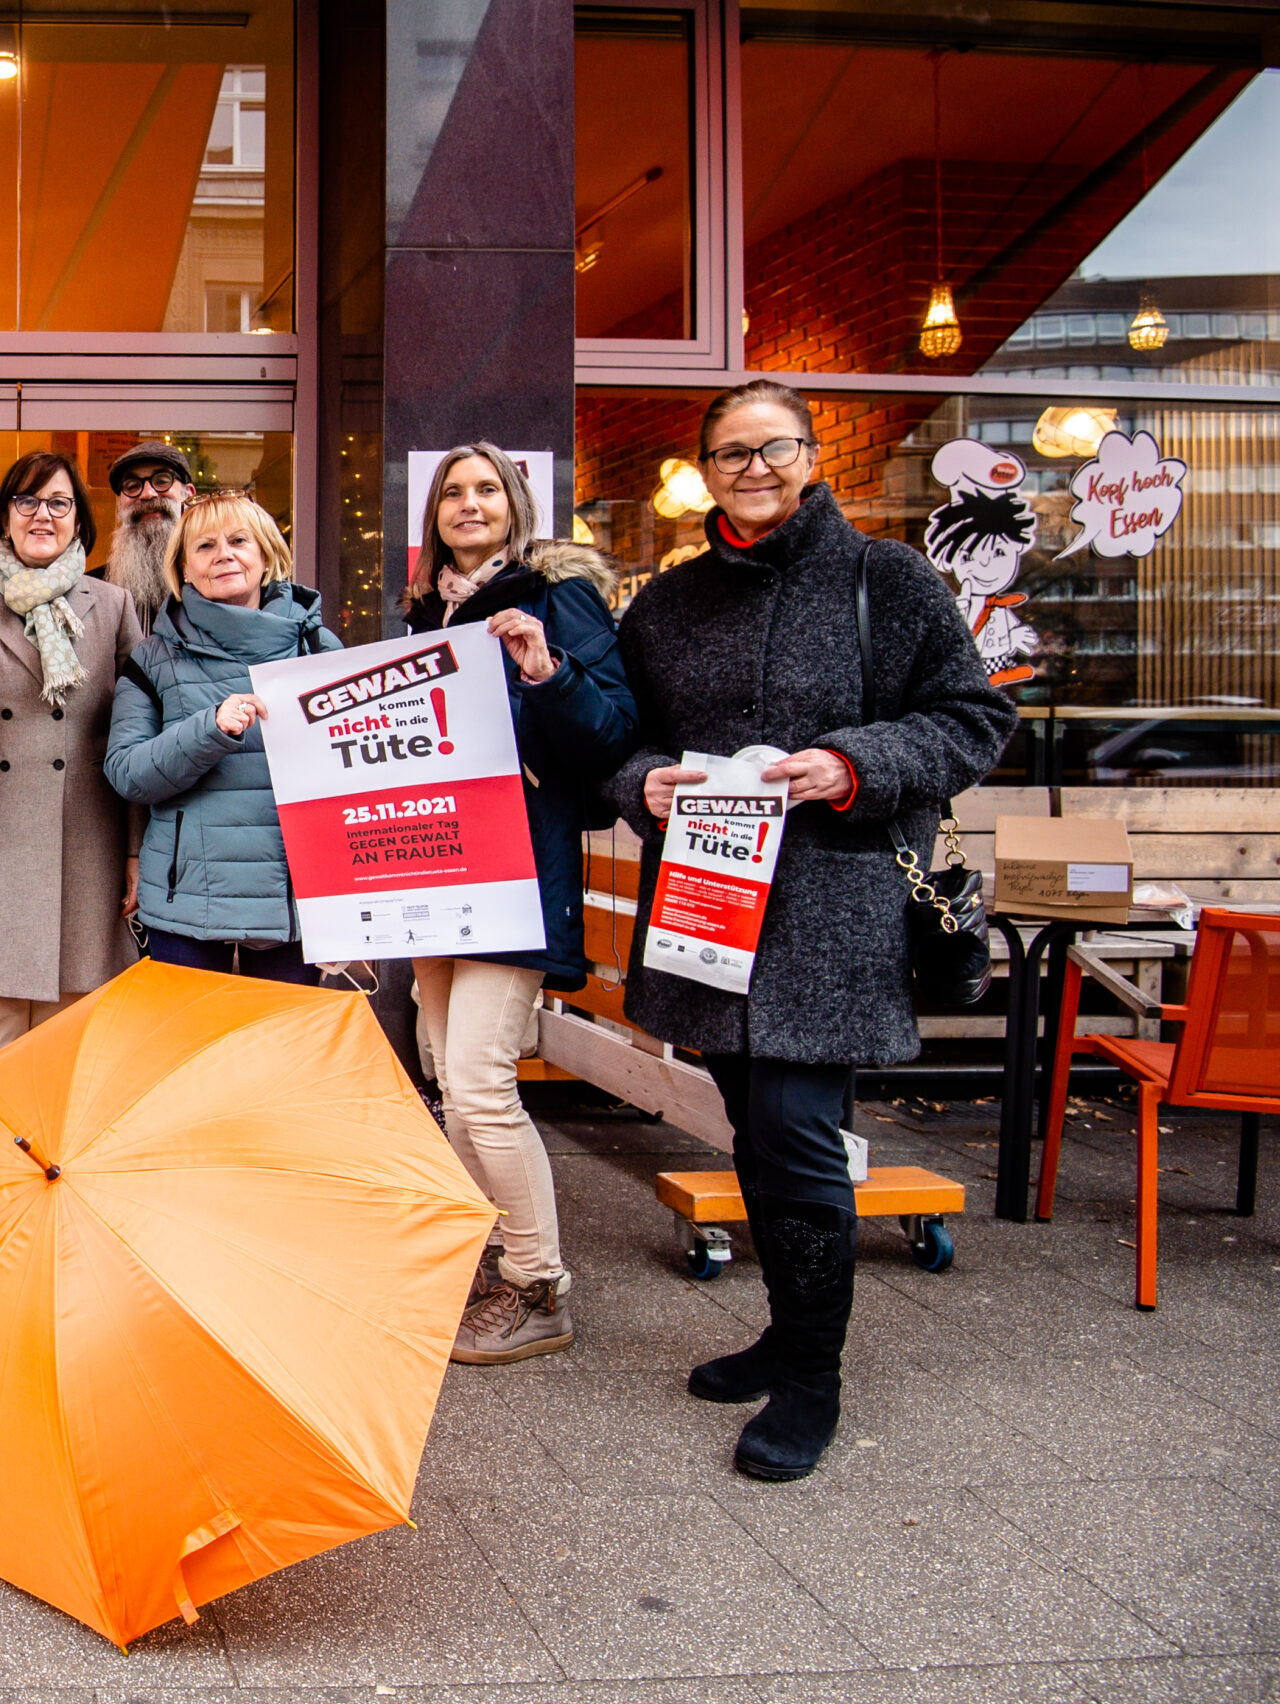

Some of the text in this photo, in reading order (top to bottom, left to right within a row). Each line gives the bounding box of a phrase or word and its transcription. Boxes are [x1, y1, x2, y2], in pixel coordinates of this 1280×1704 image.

[1088, 465, 1174, 506] Kopf hoch
[1110, 507, 1163, 538] Essen
[308, 651, 442, 717] GEWALT
[379, 697, 426, 711] kommt
[328, 714, 428, 738] nicht in die
[342, 796, 457, 825] 25.11.2021
[681, 799, 776, 814] GEWALT
[347, 820, 459, 839] Internationaler Tag
[687, 819, 728, 835] nicht
[740, 832, 753, 840] die
[724, 818, 755, 829] kommt
[349, 830, 460, 850] GEGEN GEWALT
[352, 843, 463, 866] AN FRAUEN
[669, 871, 687, 880] Hilfe
[688, 875, 702, 883] und
[703, 878, 758, 897] Unterstützung
